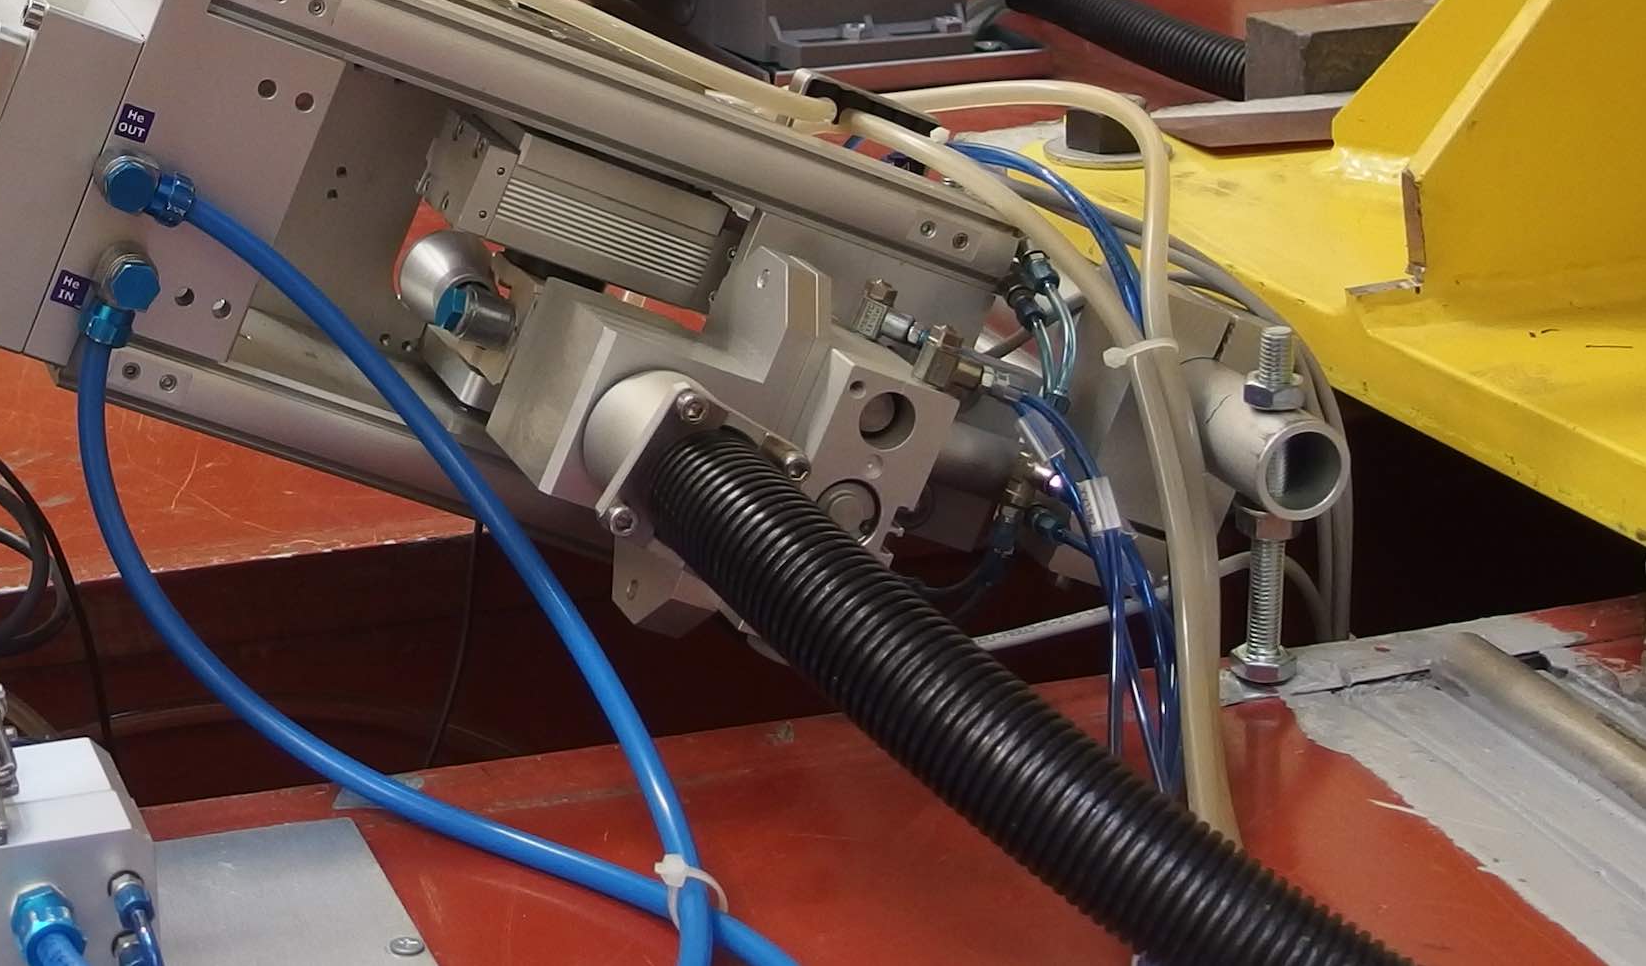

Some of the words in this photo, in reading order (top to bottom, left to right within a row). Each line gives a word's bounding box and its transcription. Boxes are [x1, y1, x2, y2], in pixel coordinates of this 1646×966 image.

[127, 109, 145, 124] He
[118, 121, 146, 138] OUT
[62, 275, 81, 290] He
[57, 288, 75, 302] IN
